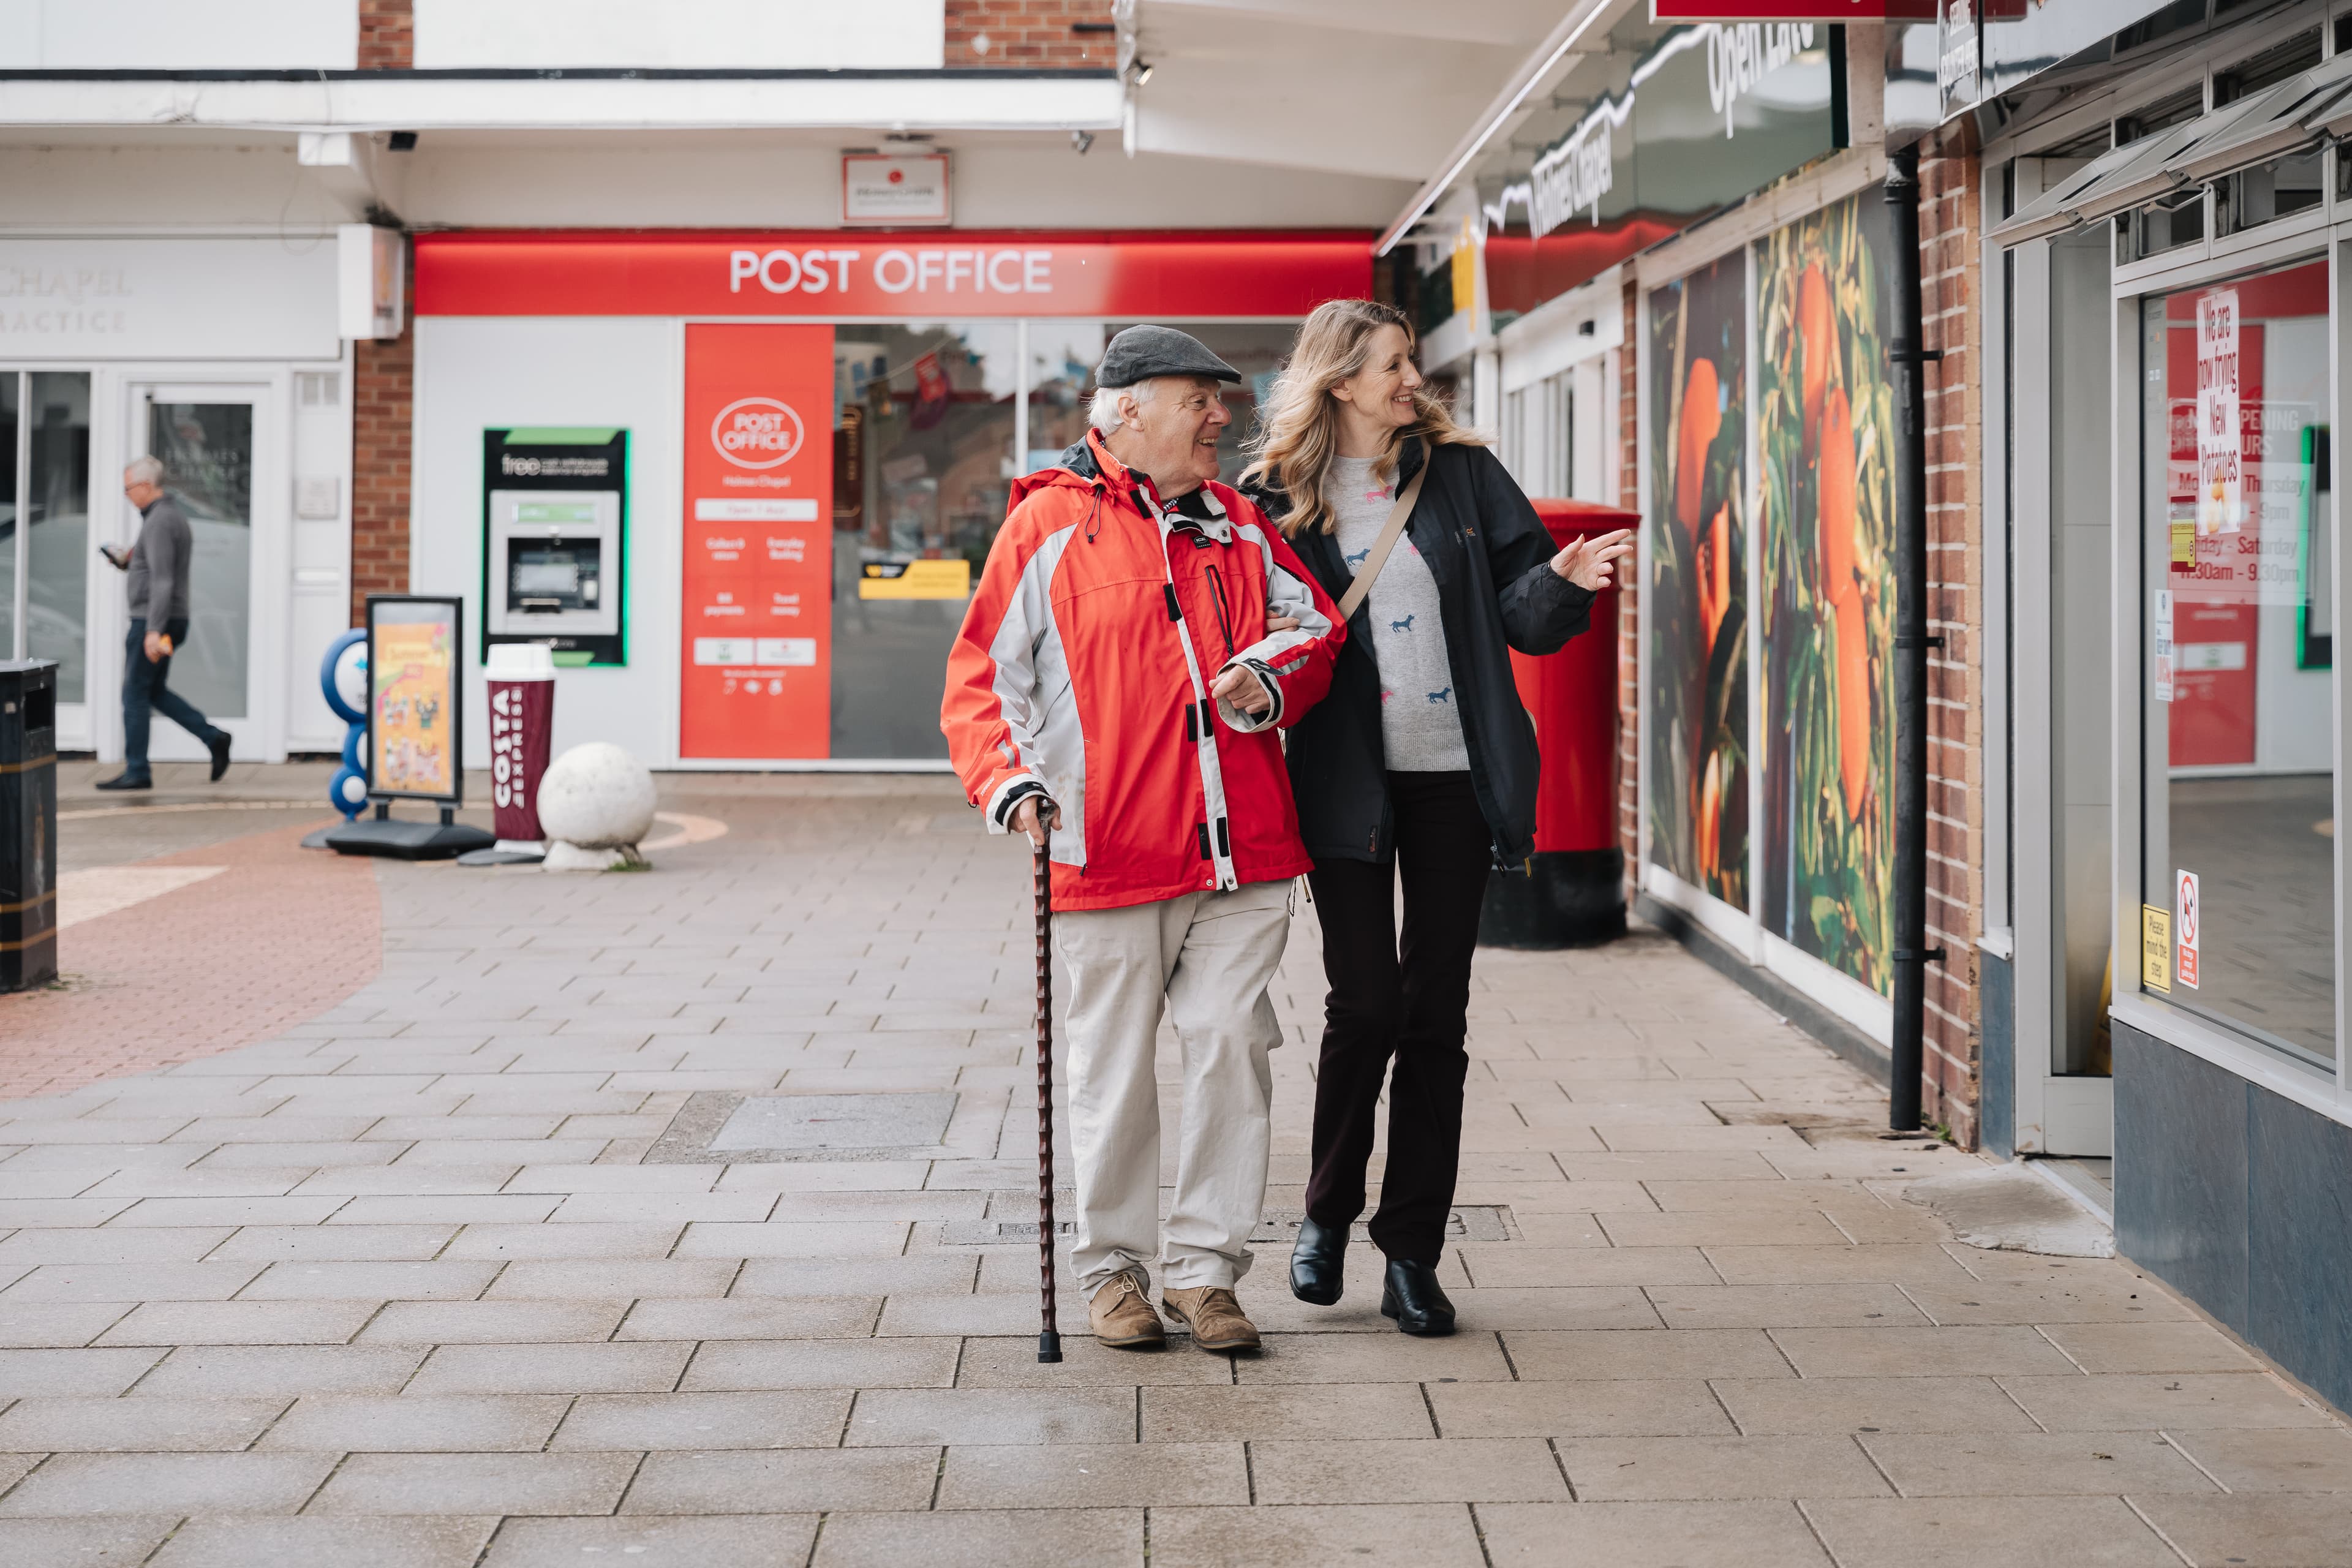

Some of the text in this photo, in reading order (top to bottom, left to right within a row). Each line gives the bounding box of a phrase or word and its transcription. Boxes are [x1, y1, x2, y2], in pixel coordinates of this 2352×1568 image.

[1708, 23, 1762, 140] Open
[1571, 115, 1613, 227] Chapel
[730, 249, 1052, 293] POST OFFICE
[2203, 300, 2230, 342] We are
[2198, 343, 2237, 395] now frying
[734, 413, 785, 432] POST
[2210, 394, 2226, 437] New
[2239, 409, 2299, 431] PENING
[722, 430, 791, 450] OFFICE
[2239, 434, 2274, 456] URS
[2201, 443, 2237, 486] Potatoes
[2245, 475, 2305, 497] Thursday
[2260, 502, 2290, 522] 9pm
[2238, 536, 2297, 558] Saturday
[2248, 563, 2300, 584] 9.30pm
[492, 689, 513, 809] COSTA
[511, 688, 524, 791] EXPRESS
[2149, 916, 2164, 937] Please
[2150, 960, 2162, 982] step
